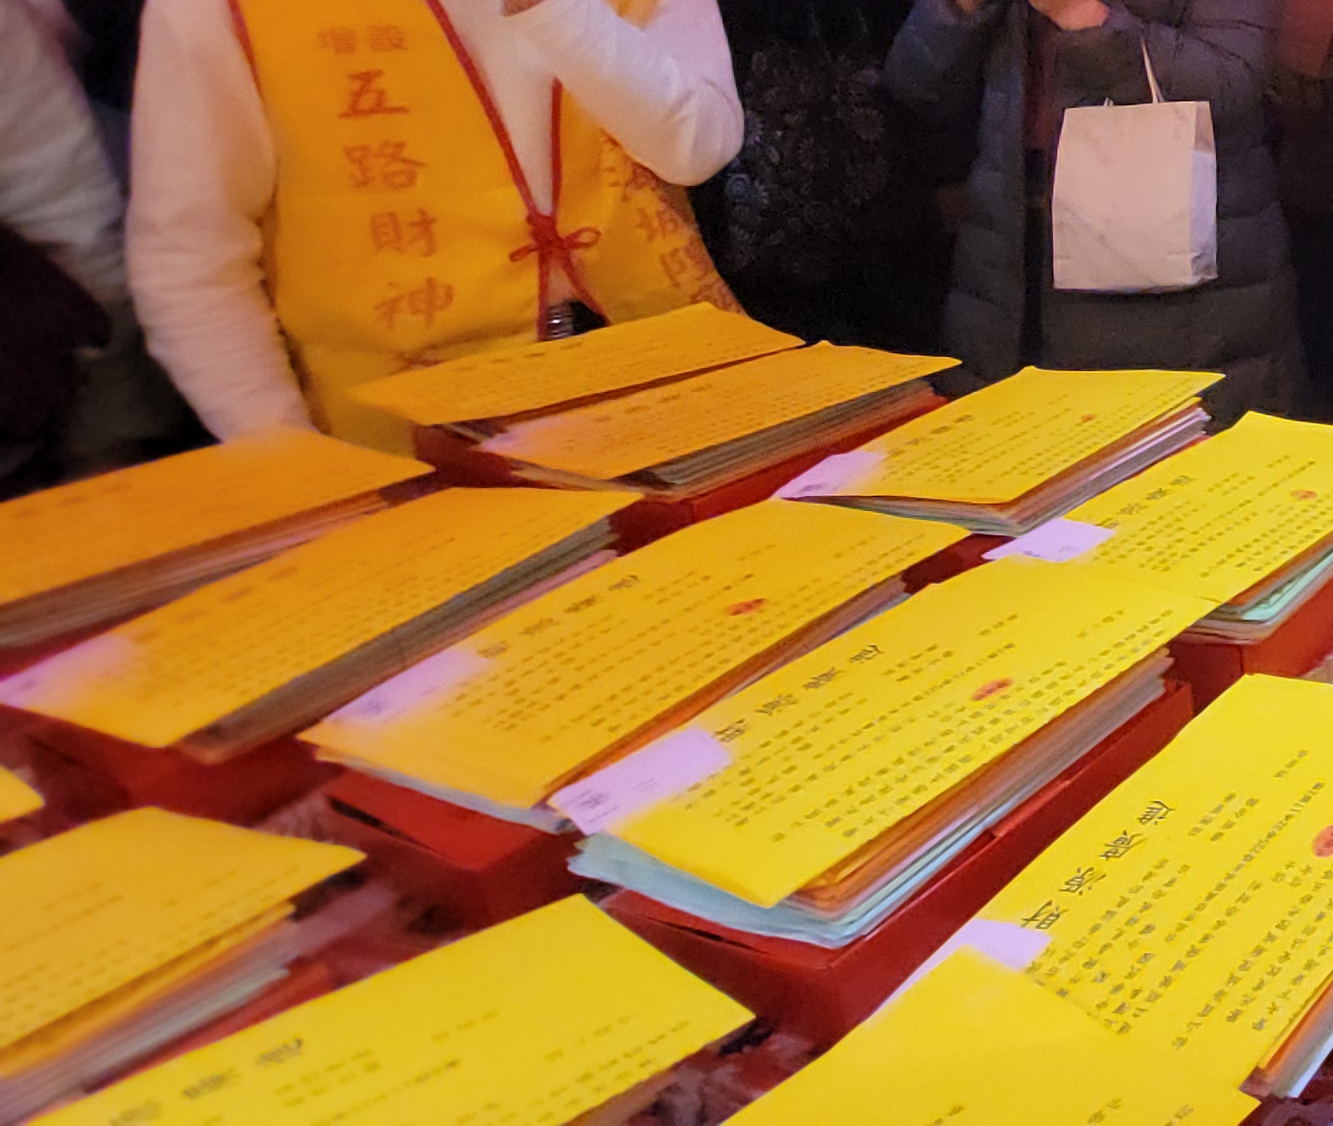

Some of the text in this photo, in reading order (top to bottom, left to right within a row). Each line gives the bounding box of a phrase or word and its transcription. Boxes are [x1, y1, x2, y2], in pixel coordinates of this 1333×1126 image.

[338, 68, 455, 332] 五路財神
[1021, 798, 1176, 933] 財源廣進
